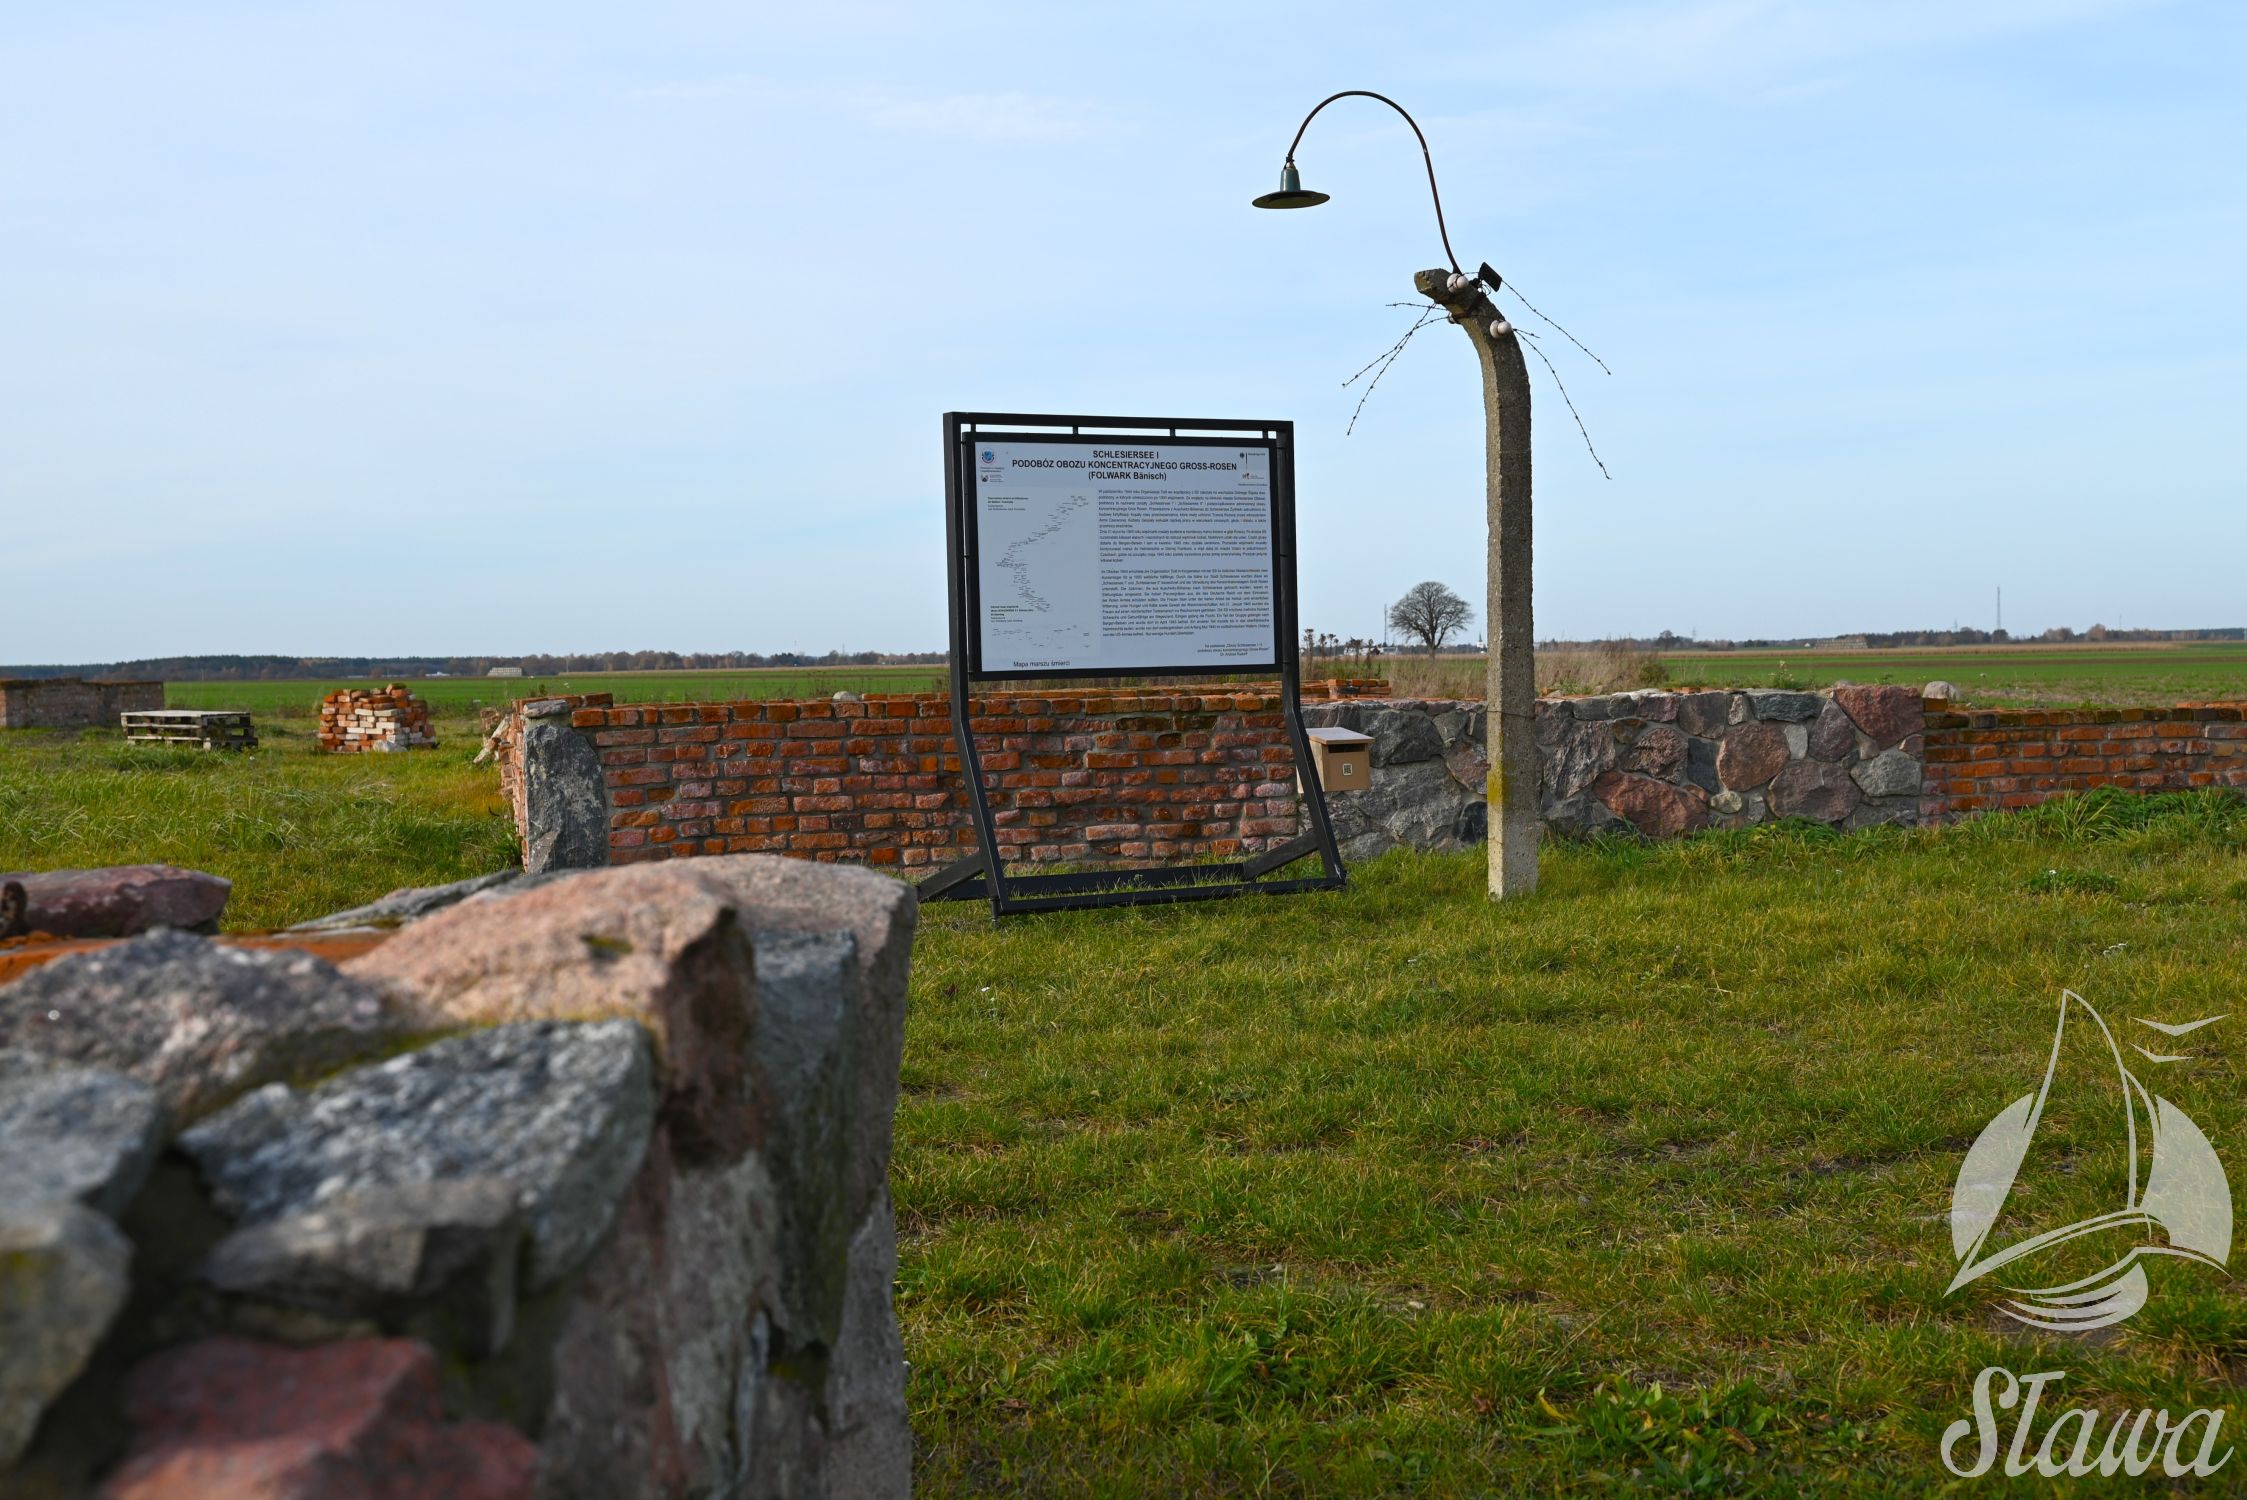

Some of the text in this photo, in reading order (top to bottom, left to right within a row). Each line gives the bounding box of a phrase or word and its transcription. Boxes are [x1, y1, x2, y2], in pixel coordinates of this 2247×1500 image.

[1093, 450, 1154, 459] SCHLESIERSEE
[1012, 458, 1237, 471] PODOBÓZ OBOZU KONCENTRACYJNEGO GROSS-ROSEN
[1088, 471, 1131, 480] (FOLWARK
